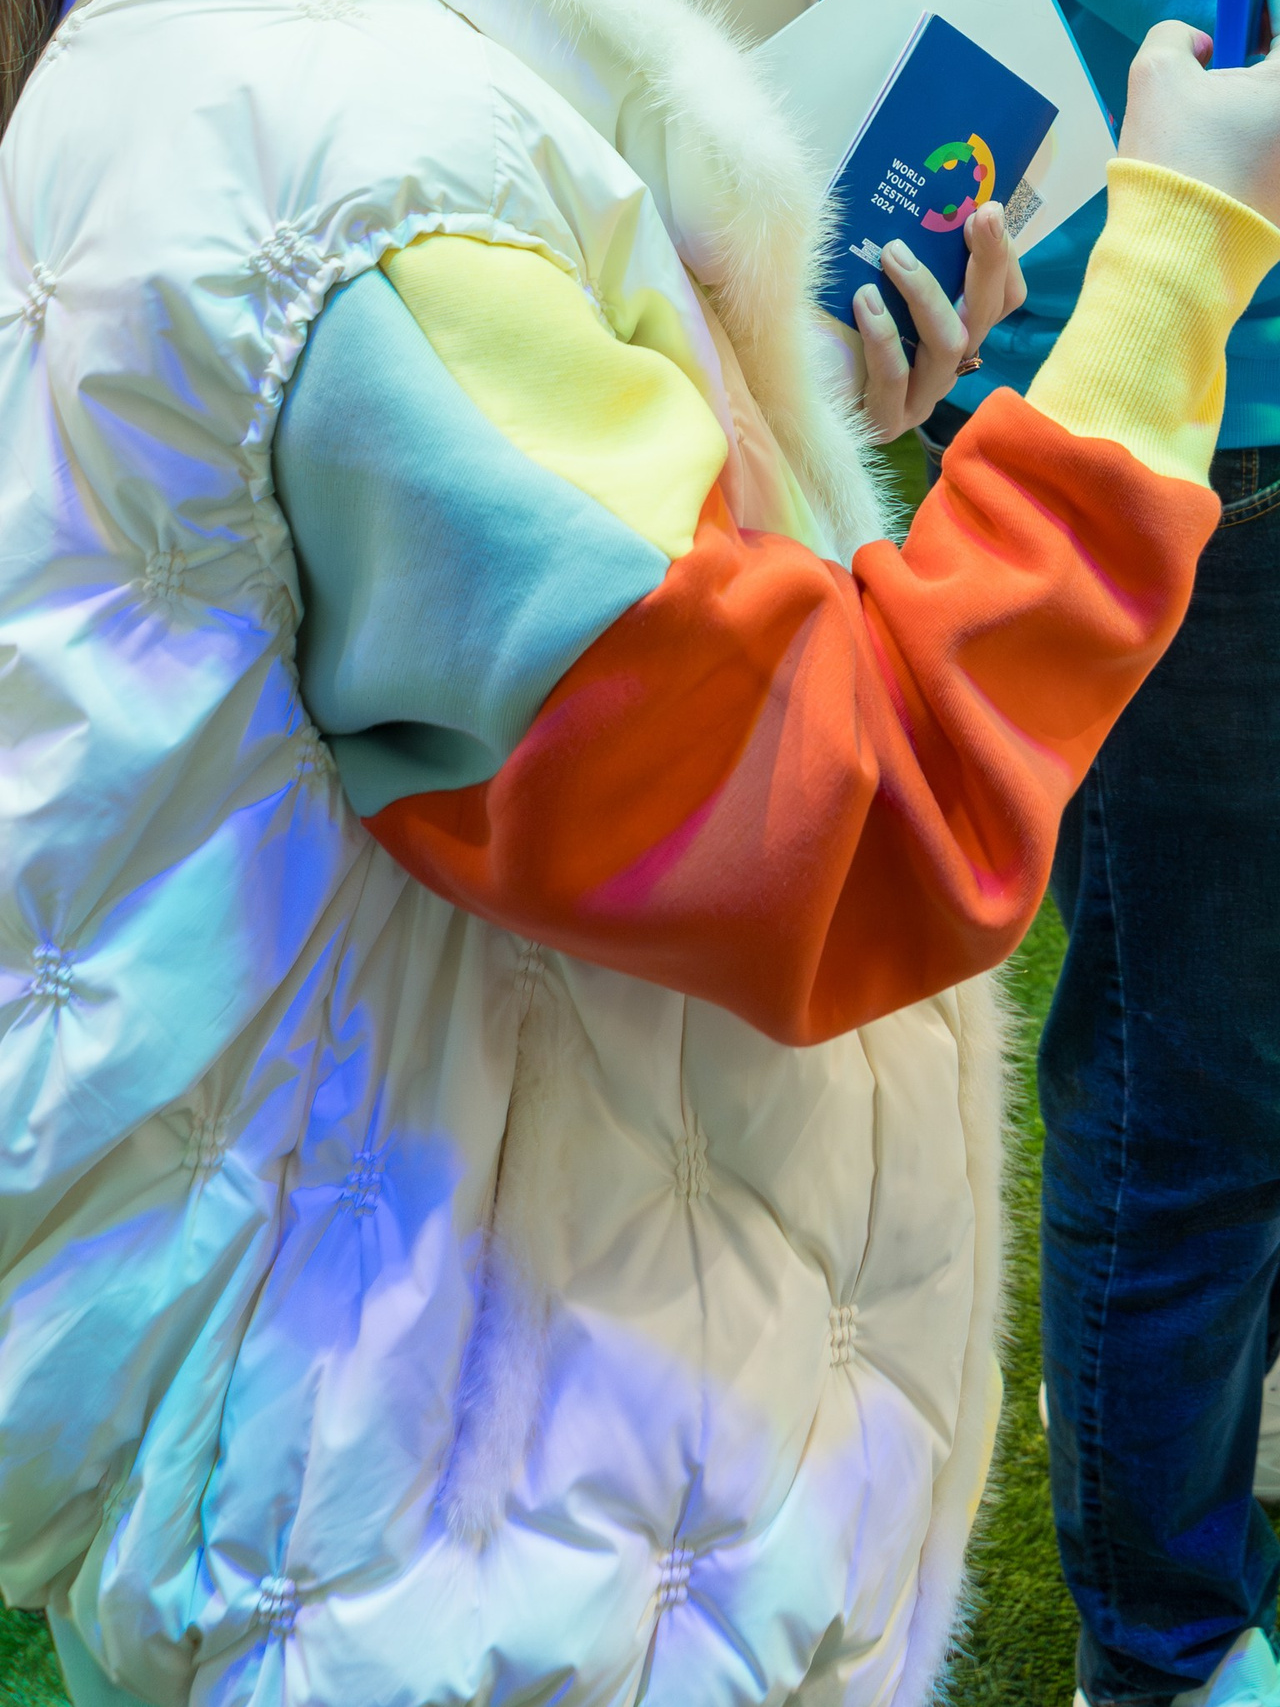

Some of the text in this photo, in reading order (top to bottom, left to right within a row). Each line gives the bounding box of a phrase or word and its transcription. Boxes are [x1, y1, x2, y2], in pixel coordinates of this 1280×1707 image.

[885, 170, 918, 198] YOUTH
[891, 158, 926, 187] WORLD
[870, 193, 895, 214] 2024
[877, 181, 920, 217] FESTIVAL
